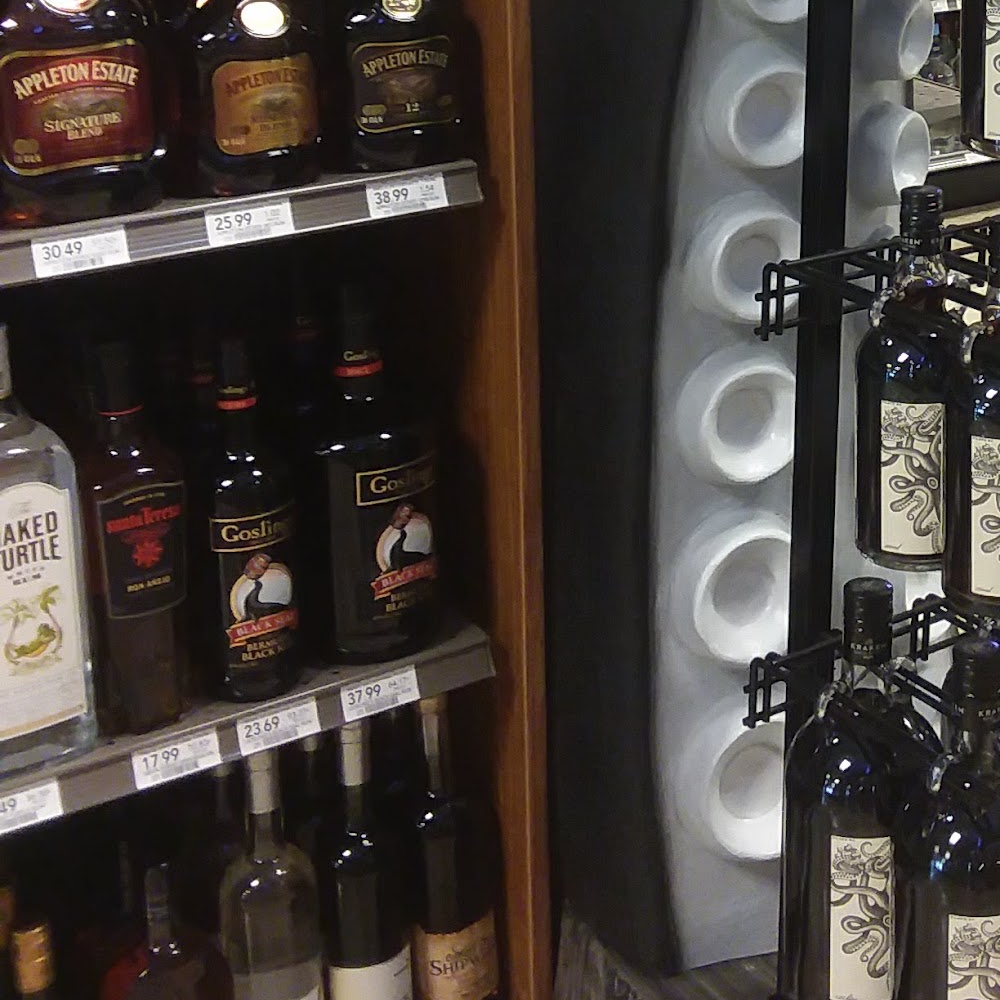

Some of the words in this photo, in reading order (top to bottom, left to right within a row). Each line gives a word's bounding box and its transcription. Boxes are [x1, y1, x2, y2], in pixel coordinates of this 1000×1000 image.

[13, 60, 89, 101] APPLETON
[91, 59, 140, 87] ESTATE
[44, 111, 122, 133] SIGNATURE
[404, 101, 421, 113] 12
[2, 510, 59, 547] AKED
[0, 534, 62, 572] URTLE
